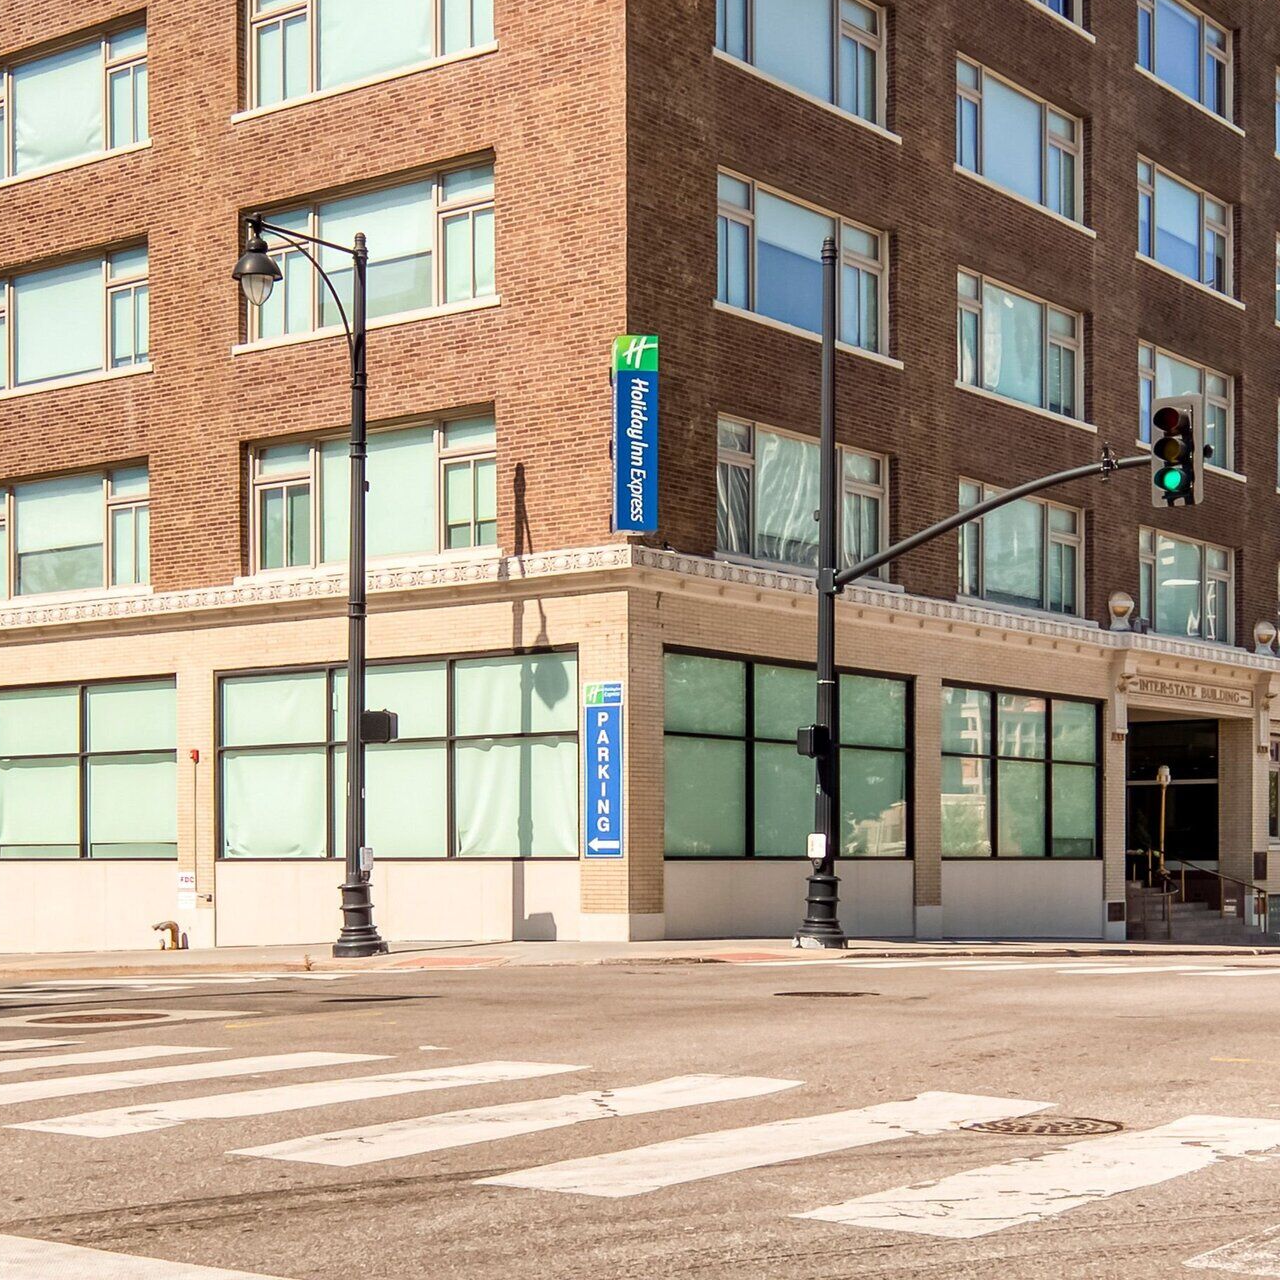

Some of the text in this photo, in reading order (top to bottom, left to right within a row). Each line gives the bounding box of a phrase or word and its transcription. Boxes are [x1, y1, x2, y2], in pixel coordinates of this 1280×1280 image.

[627, 378, 649, 522] Holiday Inn Express
[1200, 686, 1240, 703] BUILDING
[596, 711, 610, 833] PARKING
